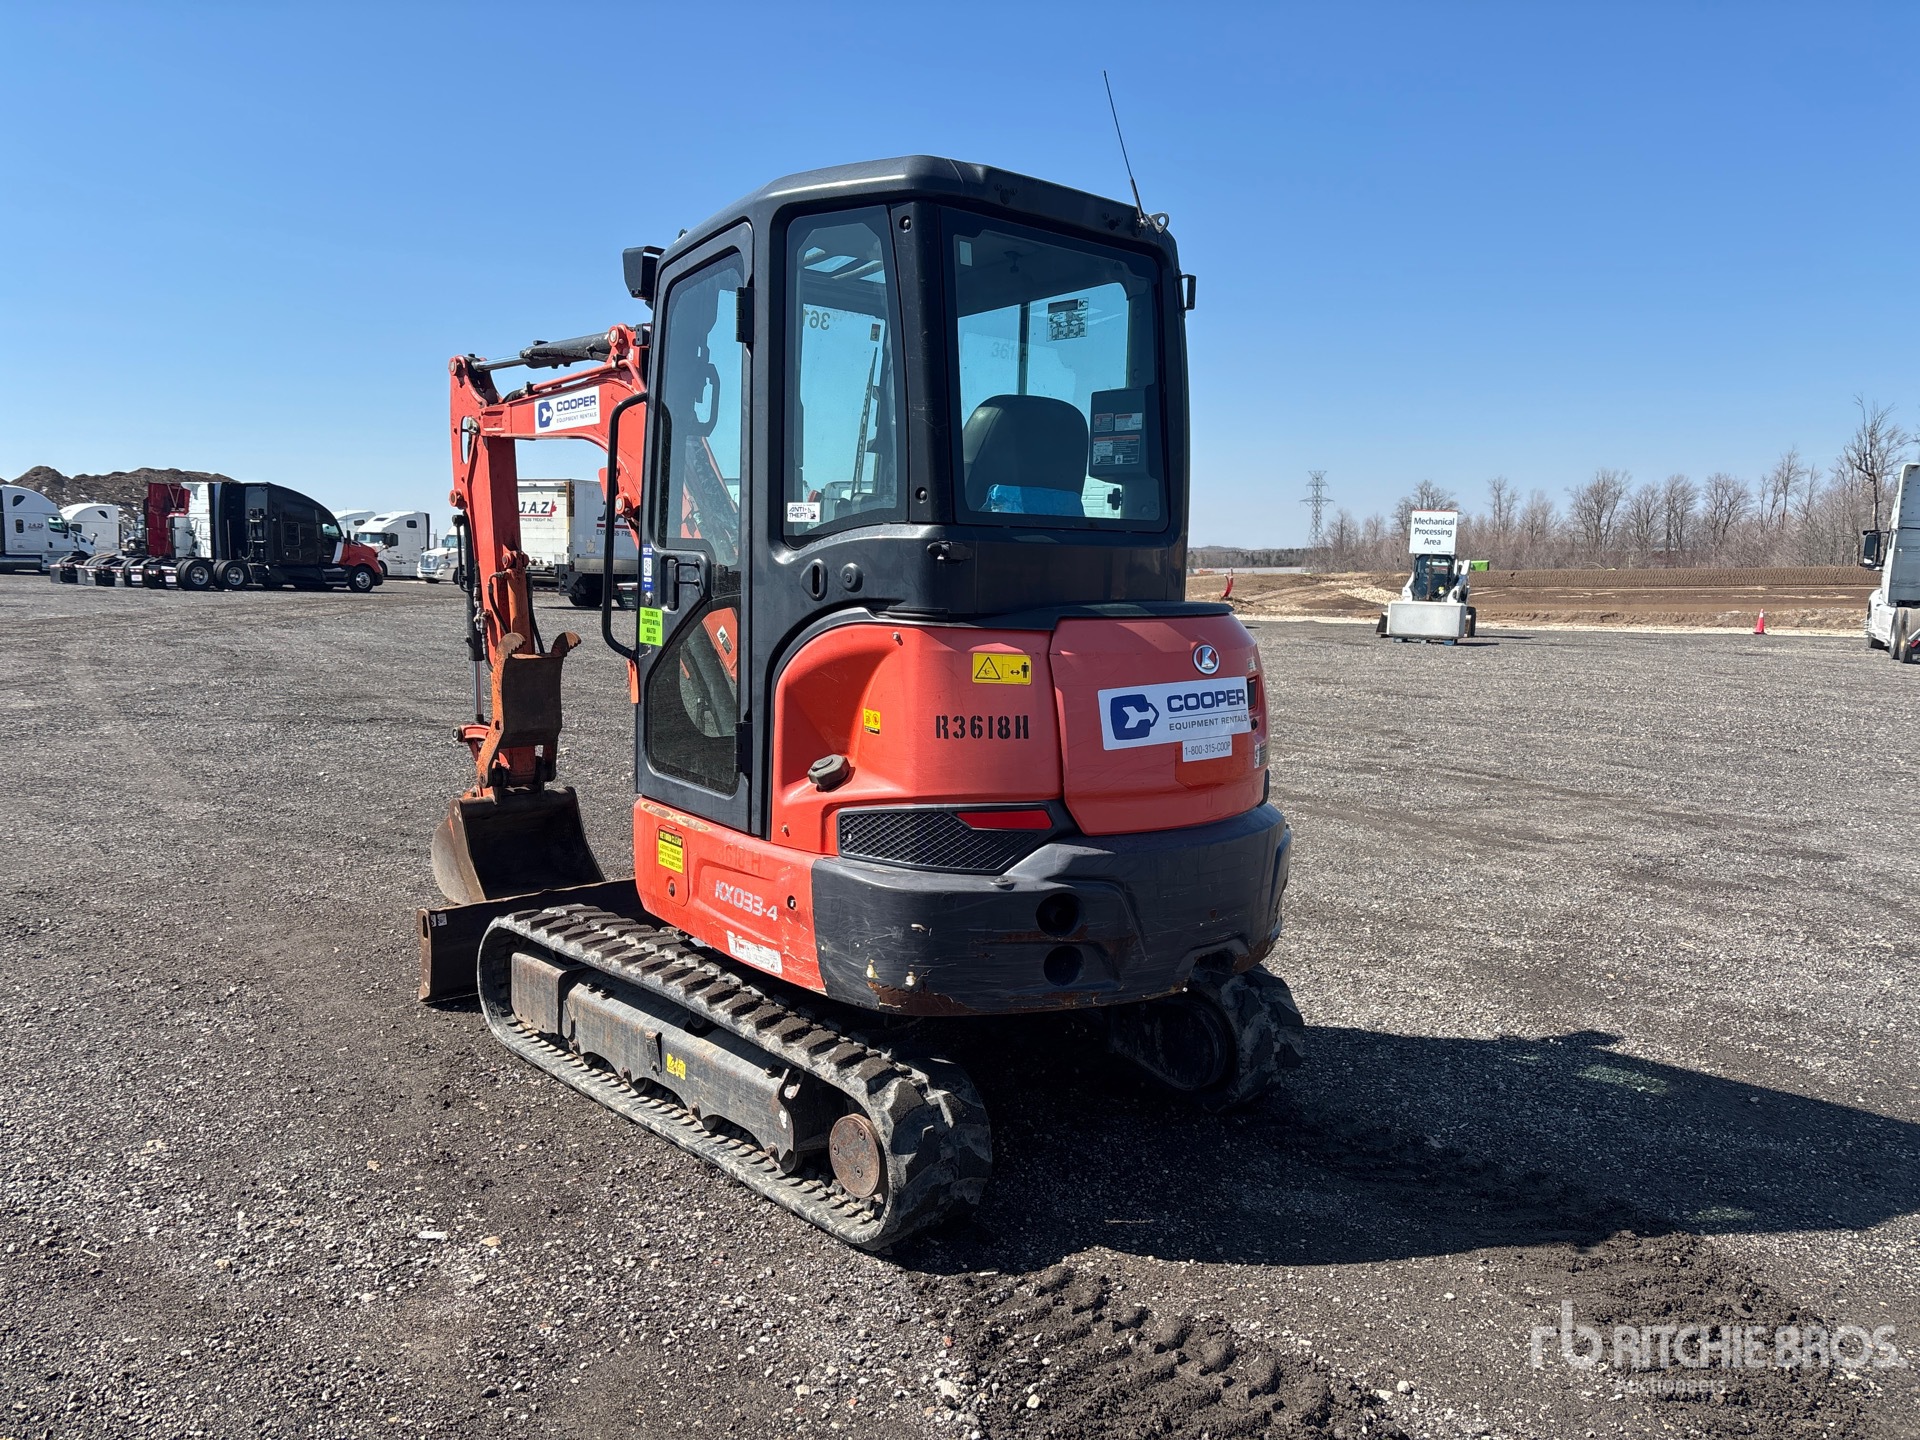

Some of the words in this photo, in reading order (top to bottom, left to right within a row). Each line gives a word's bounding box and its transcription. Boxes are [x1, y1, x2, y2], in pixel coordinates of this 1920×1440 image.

[556, 394, 597, 412] COOPER
[1414, 517, 1455, 526] Mechanical
[1414, 528, 1453, 538] Processing
[1424, 538, 1441, 546] Area
[1167, 689, 1246, 713] COOPER
[935, 715, 1029, 740] R3618H
[1169, 717, 1218, 731] EQUIPMENT
[1221, 714, 1248, 725] RENTALS
[714, 880, 778, 921] KX033-4
